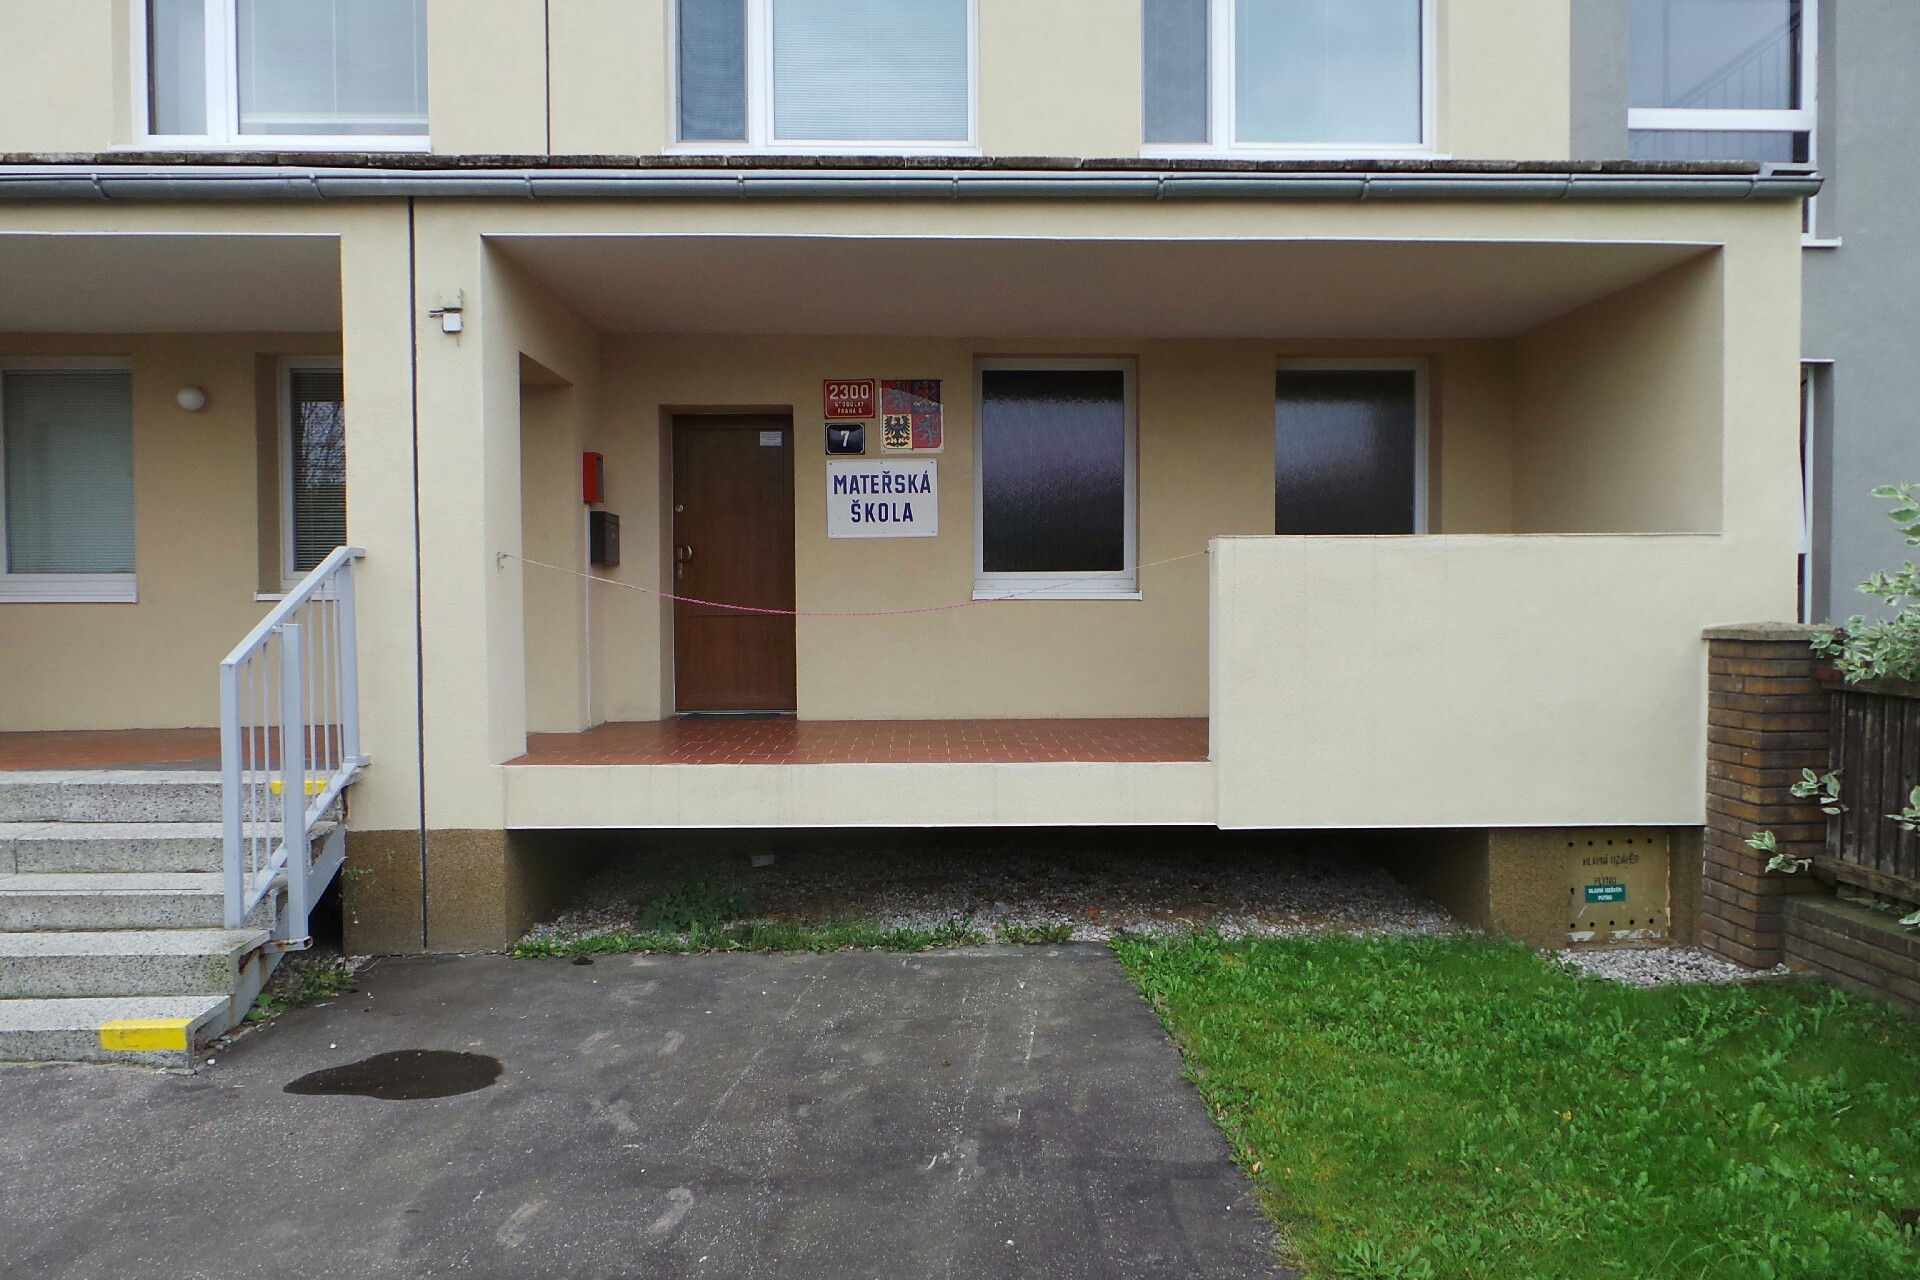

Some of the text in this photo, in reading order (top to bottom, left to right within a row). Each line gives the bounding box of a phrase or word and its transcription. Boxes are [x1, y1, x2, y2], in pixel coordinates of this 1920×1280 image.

[829, 384, 869, 400] 2300
[839, 430, 849, 448] 7
[833, 470, 931, 495] MATEŘSKÁ
[851, 499, 914, 523] ŠKOLA
